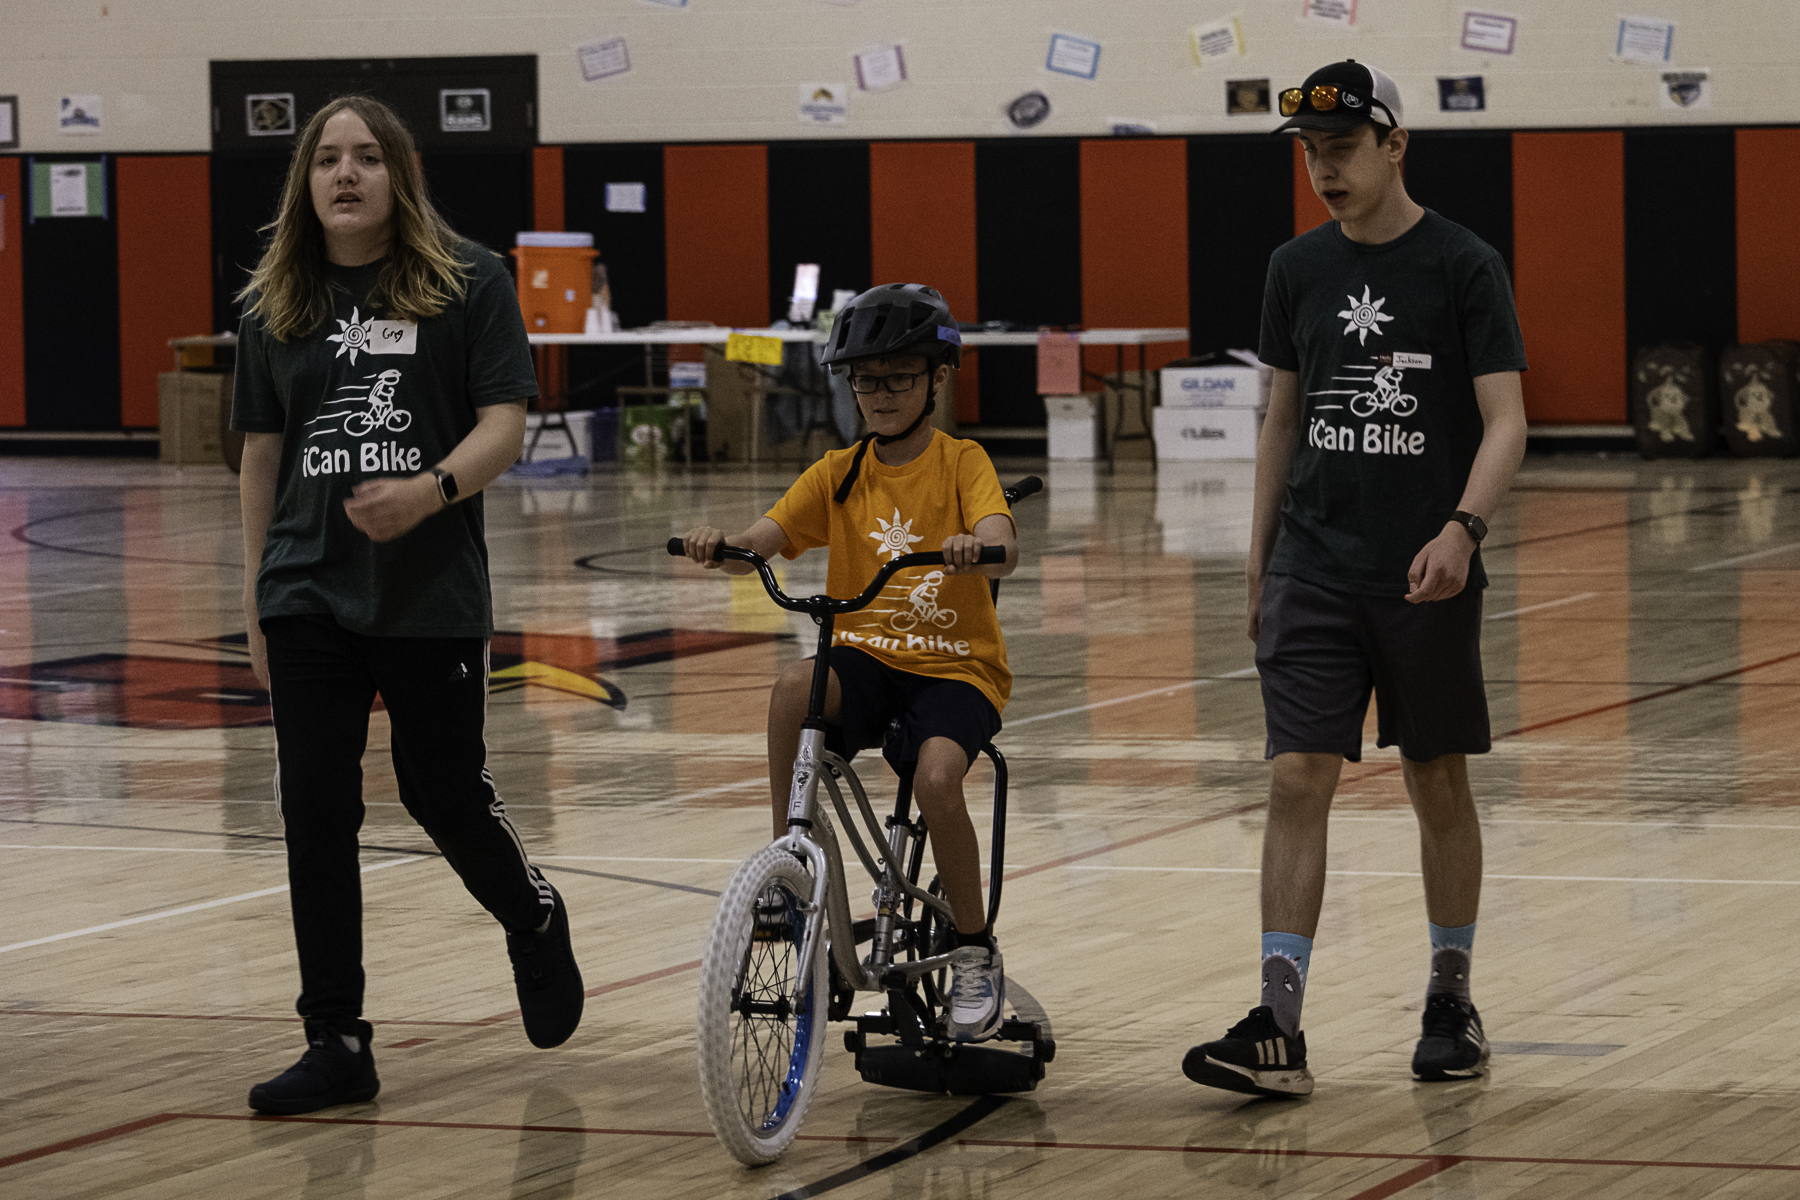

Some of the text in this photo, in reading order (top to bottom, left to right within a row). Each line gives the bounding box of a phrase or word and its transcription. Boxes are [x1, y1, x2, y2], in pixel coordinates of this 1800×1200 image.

[1308, 417, 1426, 456] iCan Bike
[303, 440, 421, 478] iCan Bike
[792, 801, 802, 812] F
